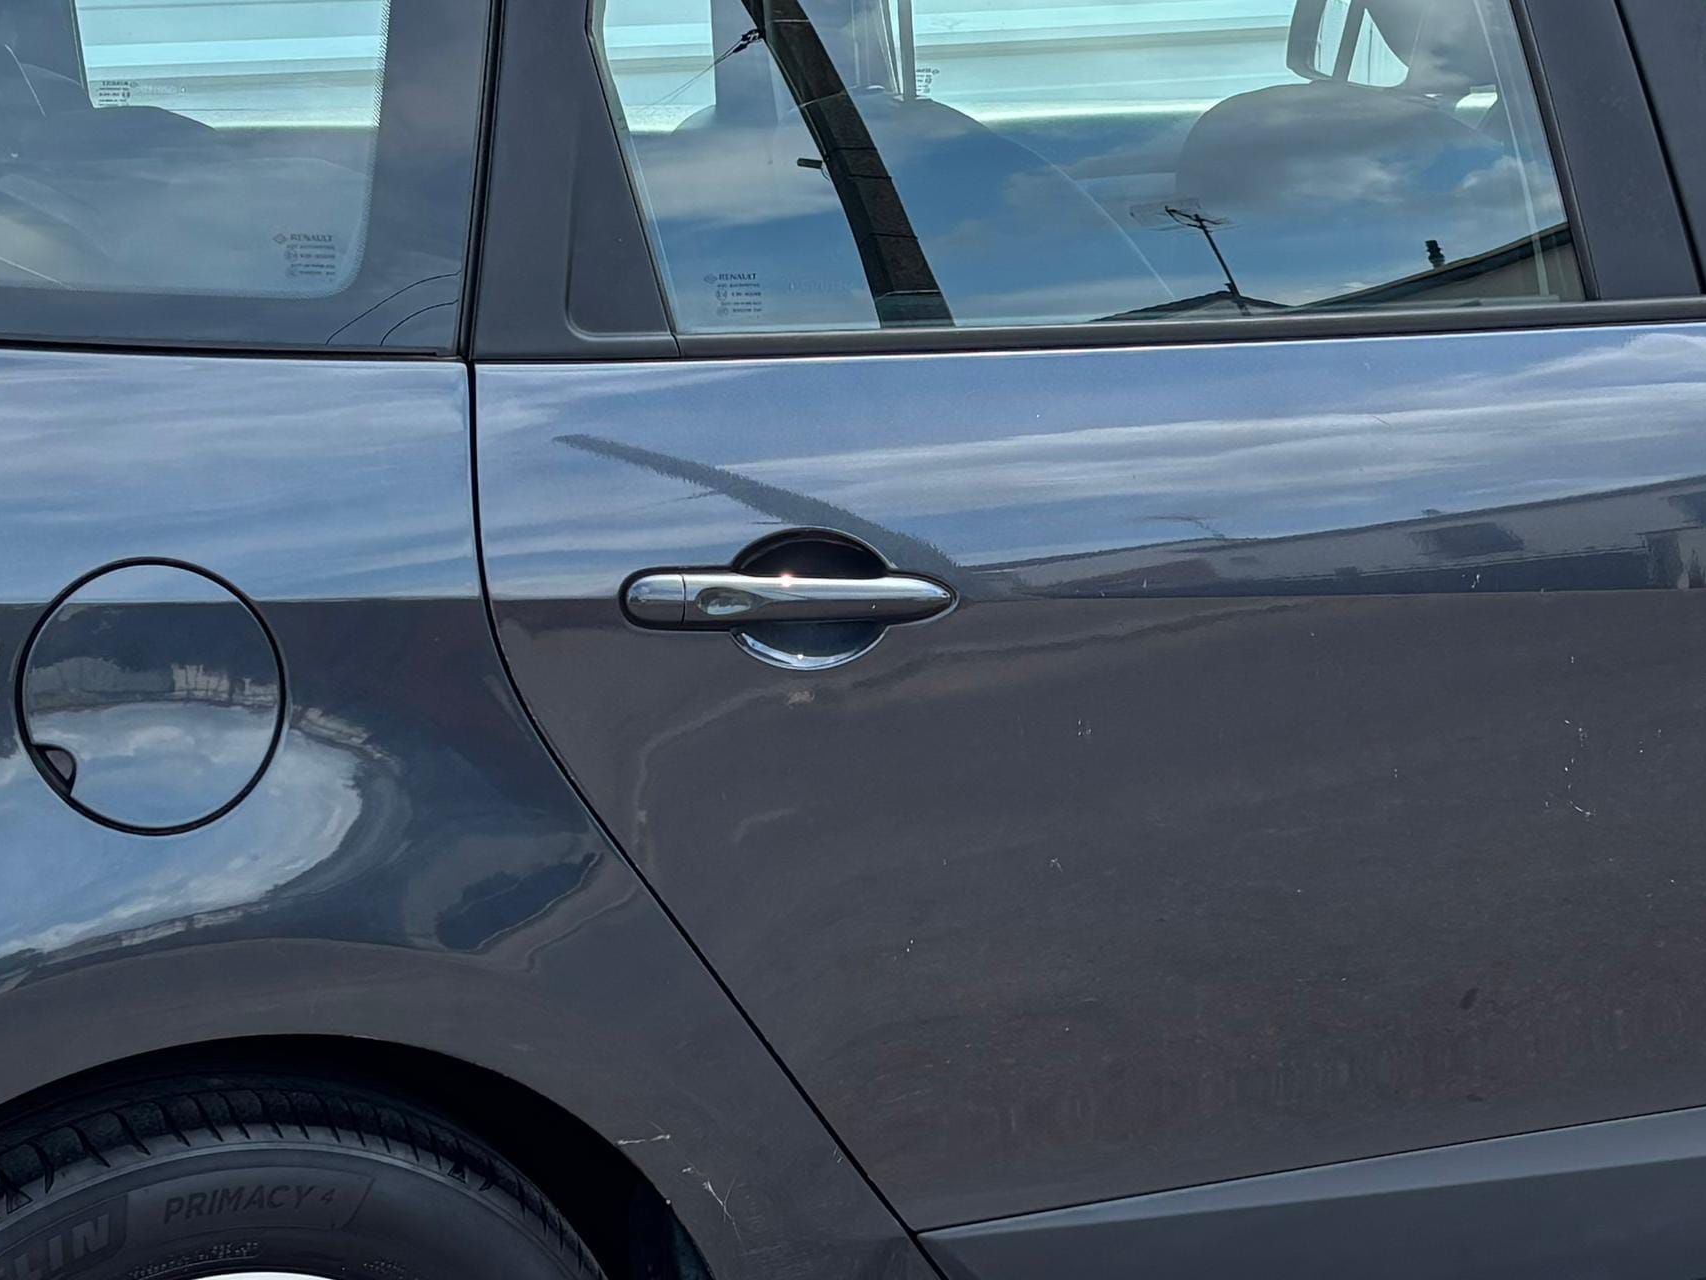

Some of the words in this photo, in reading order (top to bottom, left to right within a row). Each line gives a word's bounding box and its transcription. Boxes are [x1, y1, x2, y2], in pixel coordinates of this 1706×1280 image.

[718, 272, 757, 281] RENAULT
[163, 1180, 316, 1224] PRIMACY
[319, 1189, 335, 1205] 4
